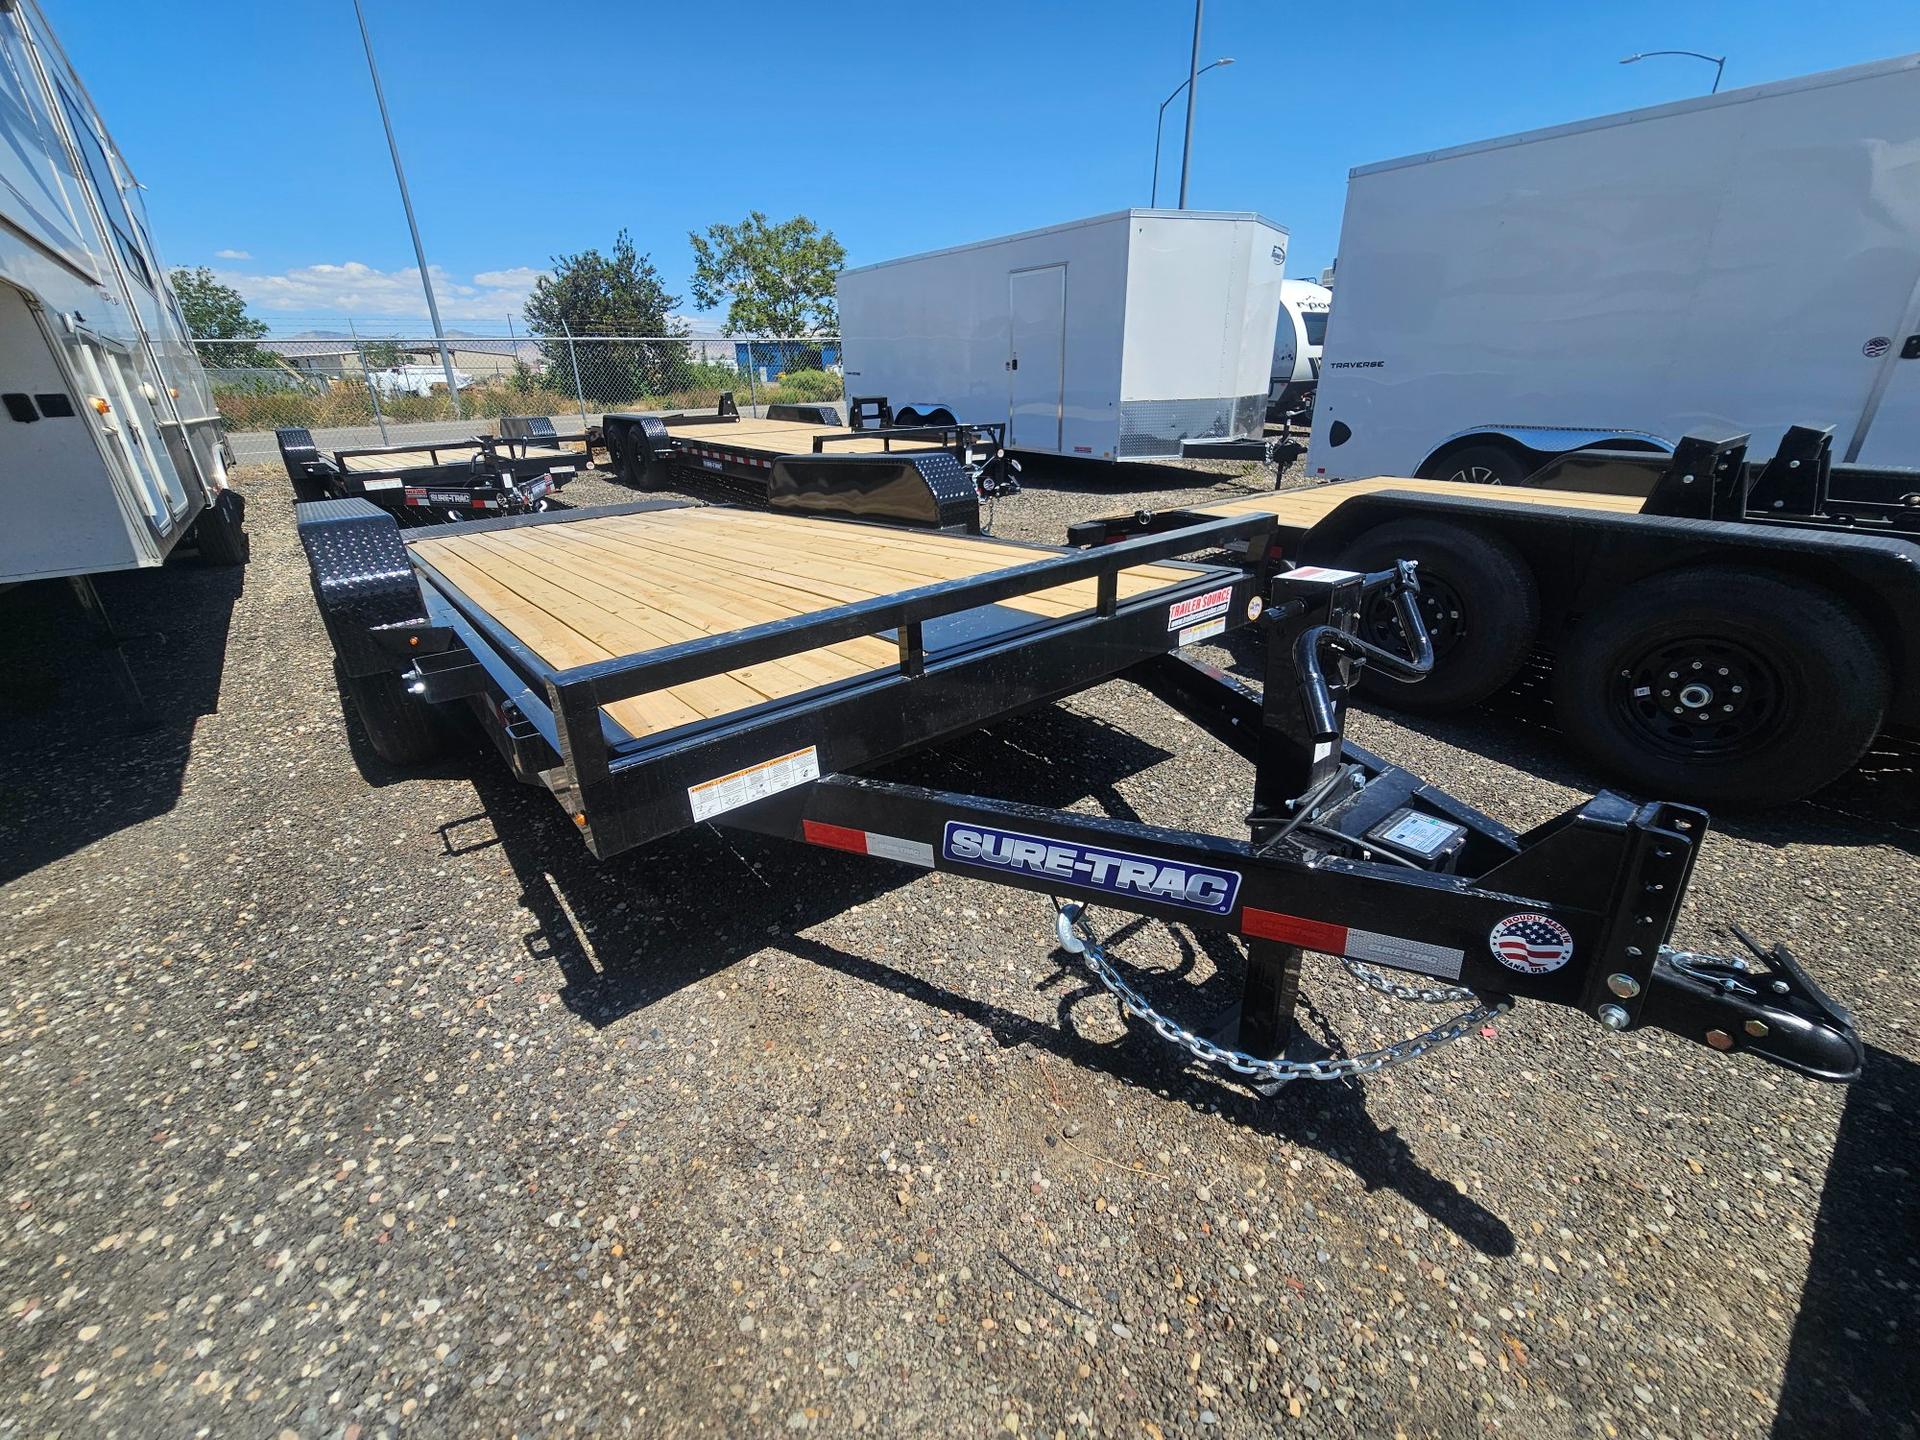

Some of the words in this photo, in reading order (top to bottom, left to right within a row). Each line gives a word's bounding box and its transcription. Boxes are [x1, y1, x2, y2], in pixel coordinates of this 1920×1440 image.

[1330, 360, 1385, 369] TRAVERSE
[1170, 597, 1202, 617] TRAILER
[1202, 587, 1231, 608] SOURCE
[950, 829, 1229, 906] SURE-TRAC
[1502, 915, 1542, 927] PROUDLY
[1544, 919, 1569, 936] MADE
[1563, 935, 1572, 944] IN
